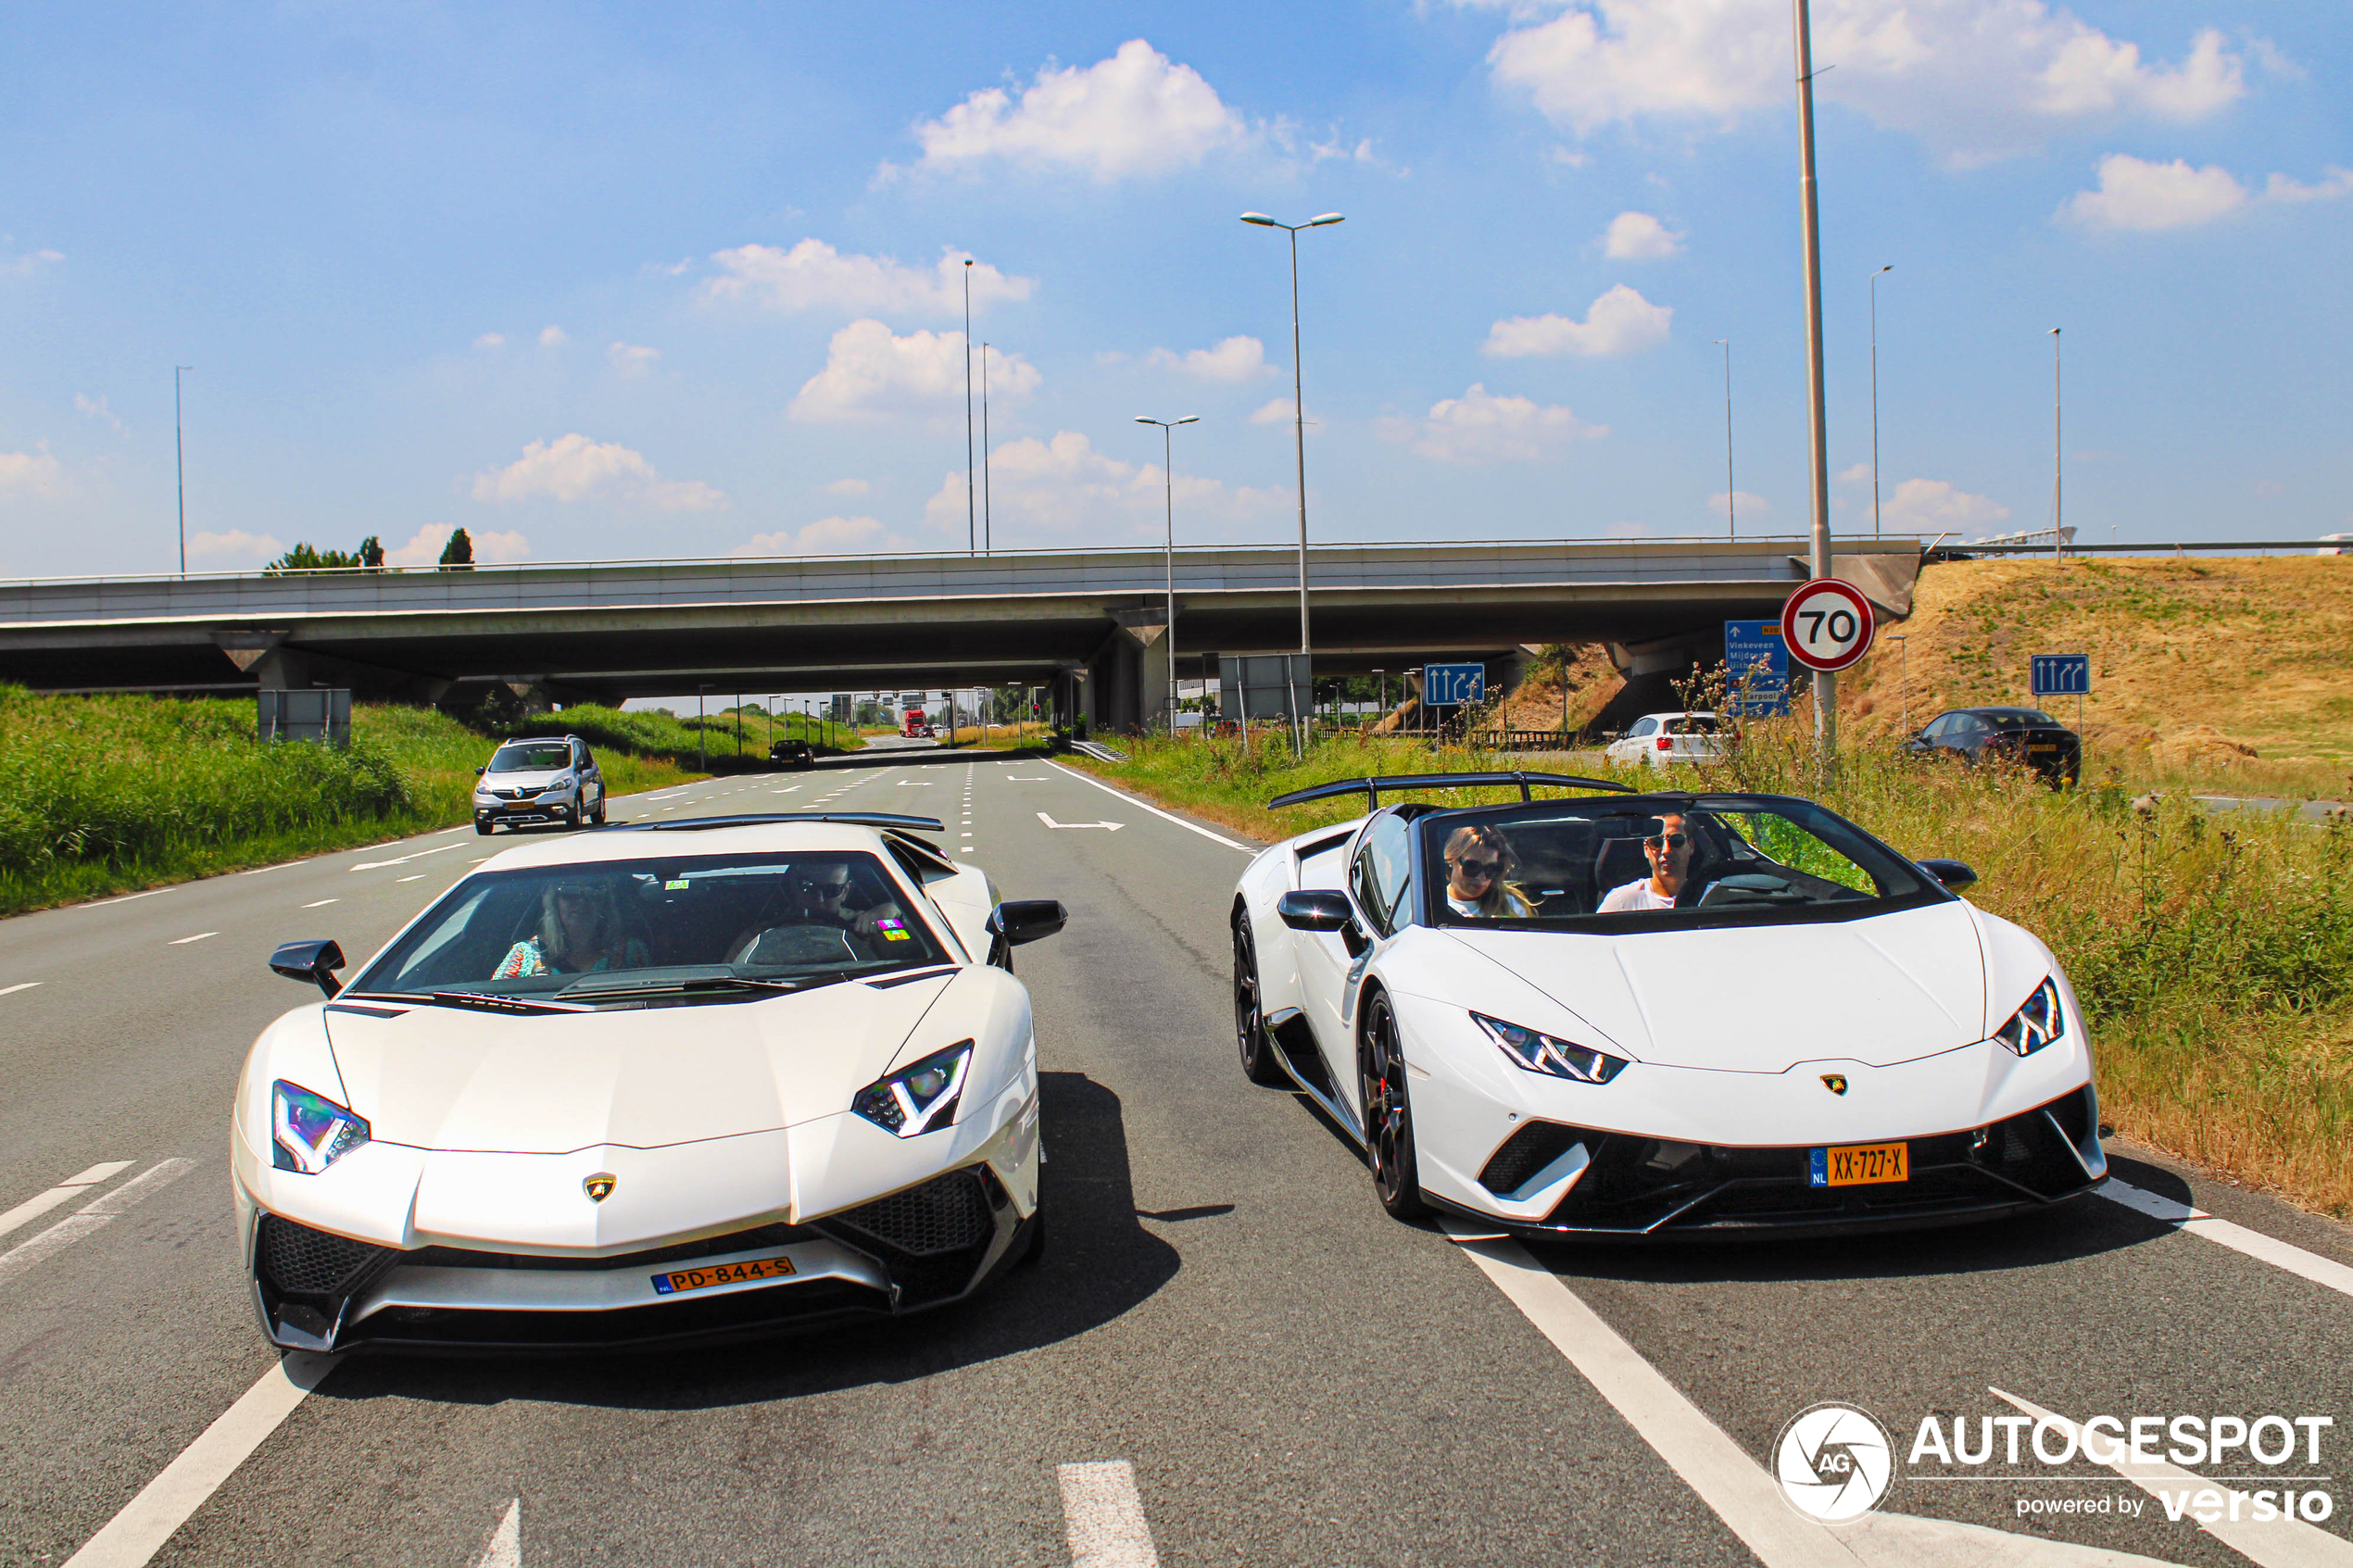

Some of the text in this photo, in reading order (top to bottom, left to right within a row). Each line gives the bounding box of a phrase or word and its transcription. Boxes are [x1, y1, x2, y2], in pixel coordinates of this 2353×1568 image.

[1799, 609, 1856, 644] 70
[1813, 1173, 1826, 1184] NL
[1834, 1148, 1901, 1180] XX-727-X
[671, 1261, 790, 1289] PD-844-S
